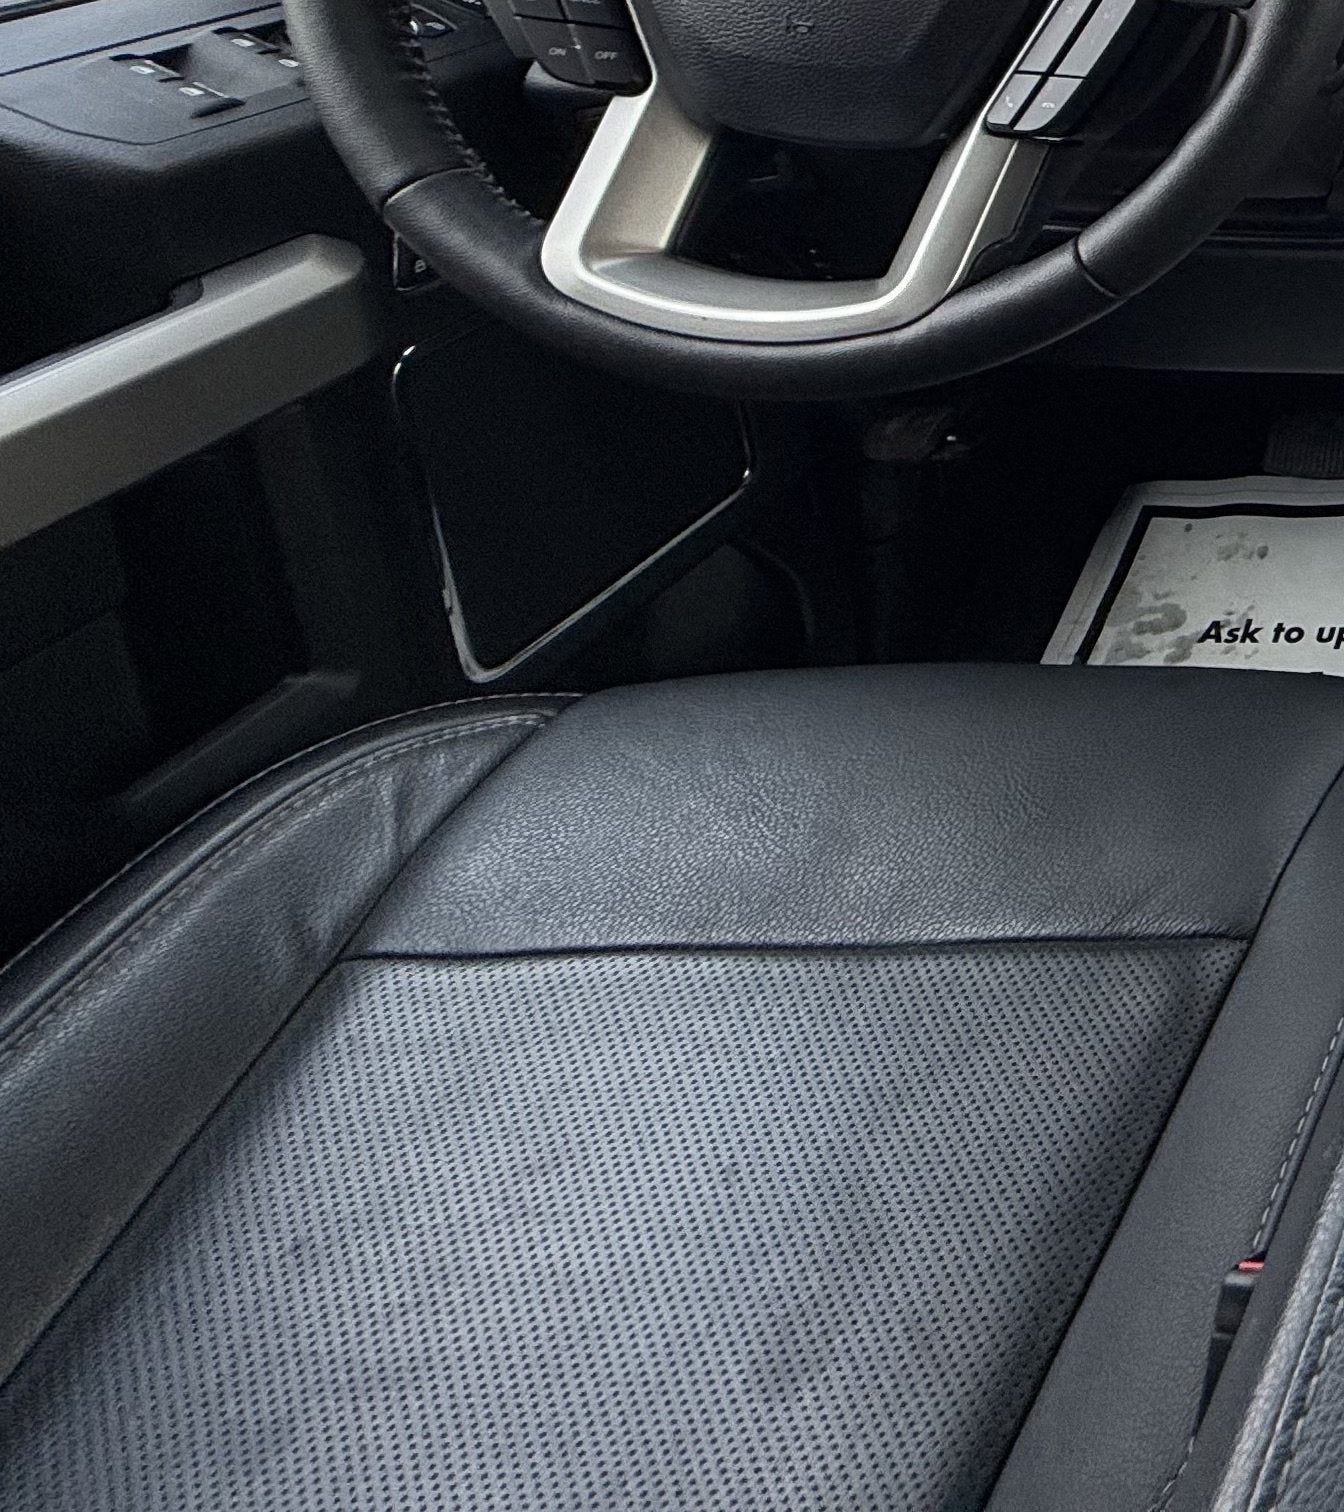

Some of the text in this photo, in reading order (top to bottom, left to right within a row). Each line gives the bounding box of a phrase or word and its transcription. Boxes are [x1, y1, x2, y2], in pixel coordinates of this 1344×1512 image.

[549, 47, 567, 57] ON
[593, 50, 619, 61] OFF
[1198, 619, 1260, 645] Ask
[1271, 619, 1305, 644] to
